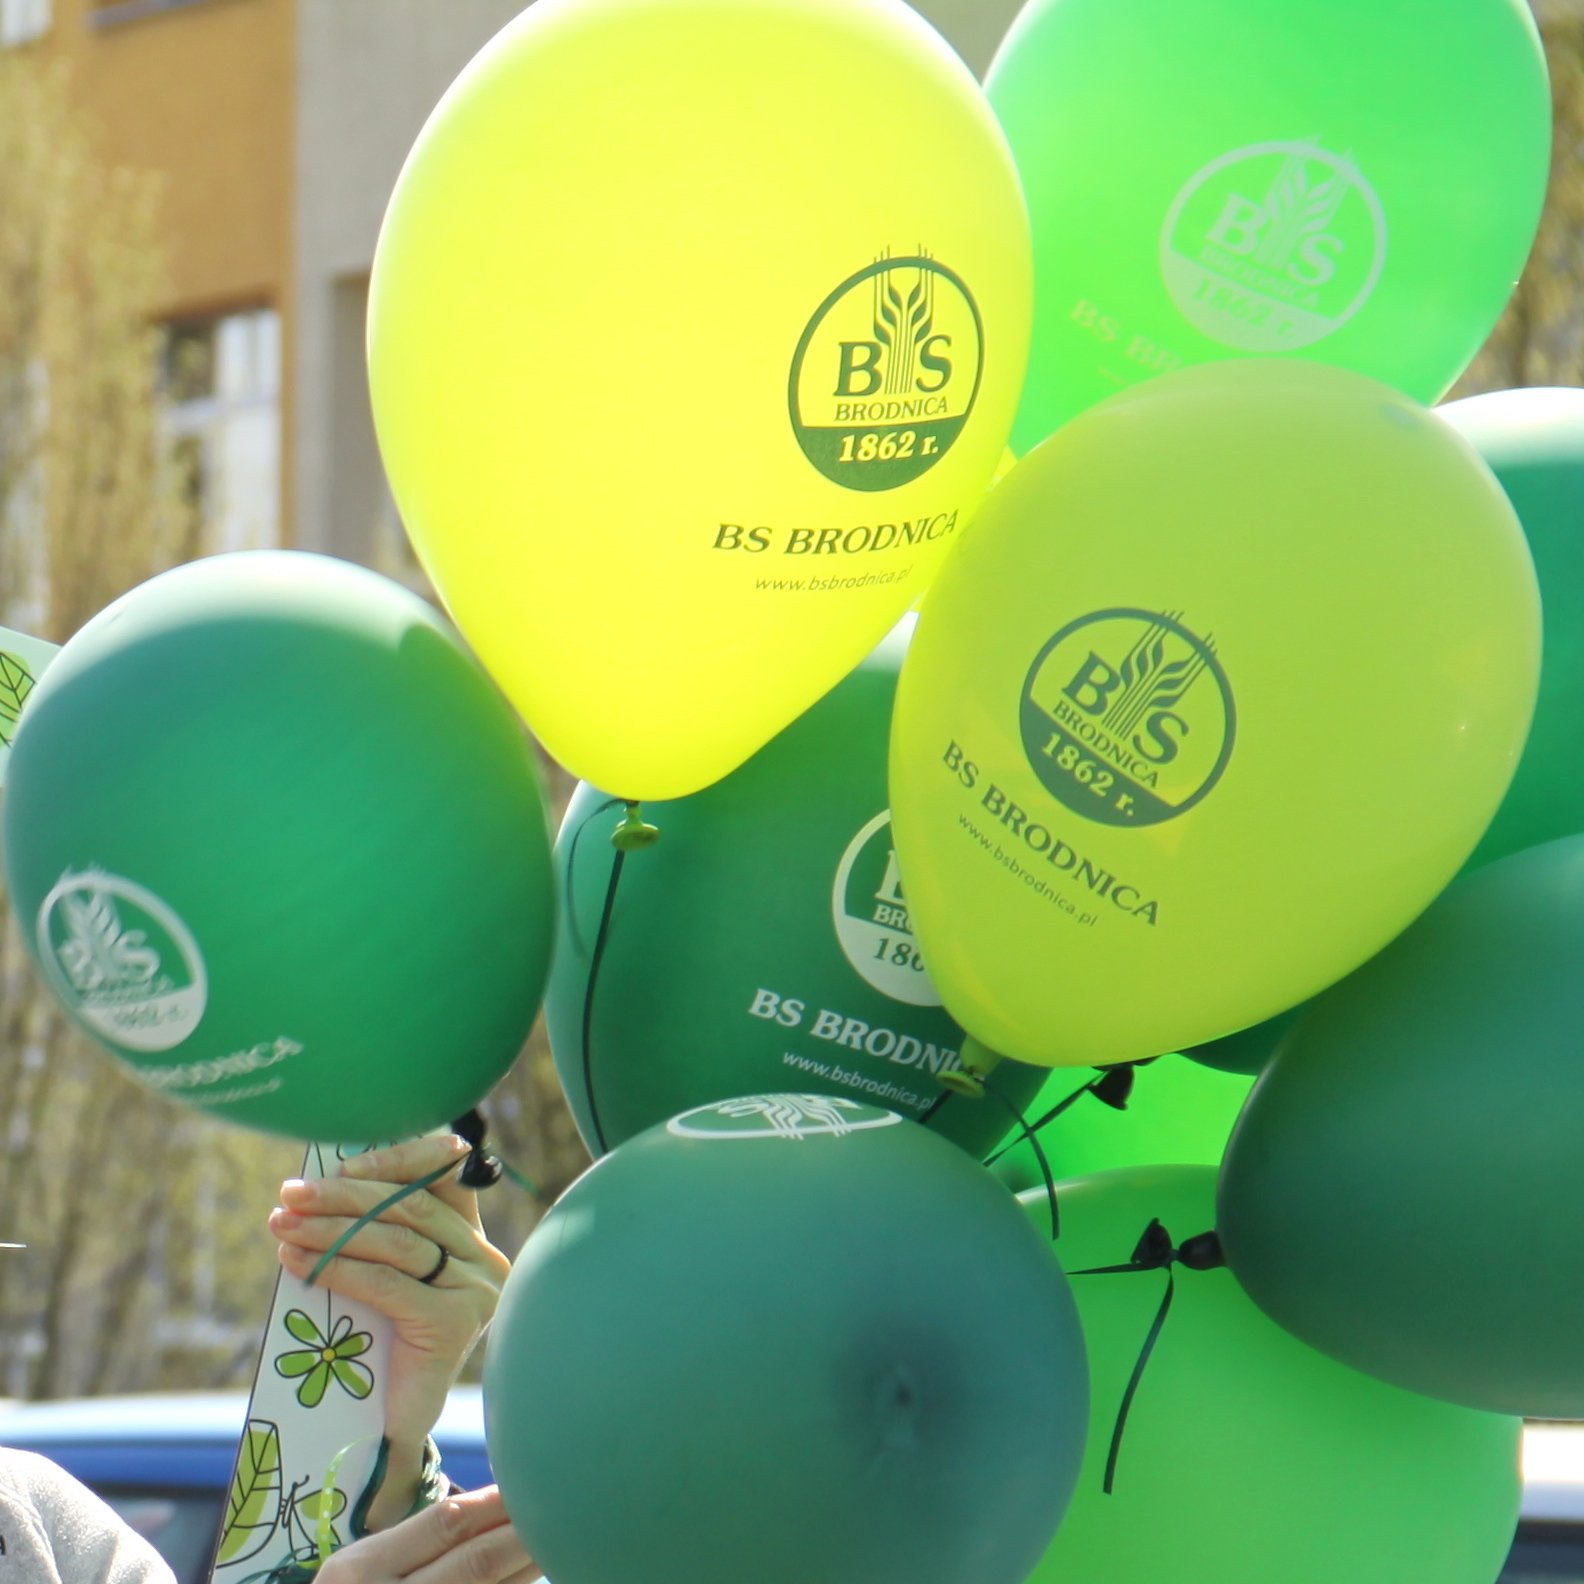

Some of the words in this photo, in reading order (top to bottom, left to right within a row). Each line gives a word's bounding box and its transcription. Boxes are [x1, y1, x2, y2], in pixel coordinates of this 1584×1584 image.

[832, 334, 952, 397] BS
[833, 395, 948, 423] BRODNICA
[838, 430, 913, 462] 1862
[920, 433, 939, 456] r.
[712, 523, 773, 553] BS
[783, 508, 959, 554] BRODNICA
[755, 564, 913, 591] www.bsbrodnica.pl
[1061, 650, 1190, 765] BS
[1042, 731, 1116, 797] 1862
[1116, 793, 1135, 816] r.
[1052, 699, 1160, 789] BRODNICA
[942, 740, 980, 789] BS
[980, 784, 1162, 926] BRODNICA
[957, 812, 1099, 928] www.bsbrodnica.pl
[748, 988, 806, 1027] BS
[782, 1051, 937, 1112] www.bsbrodnica.pl
